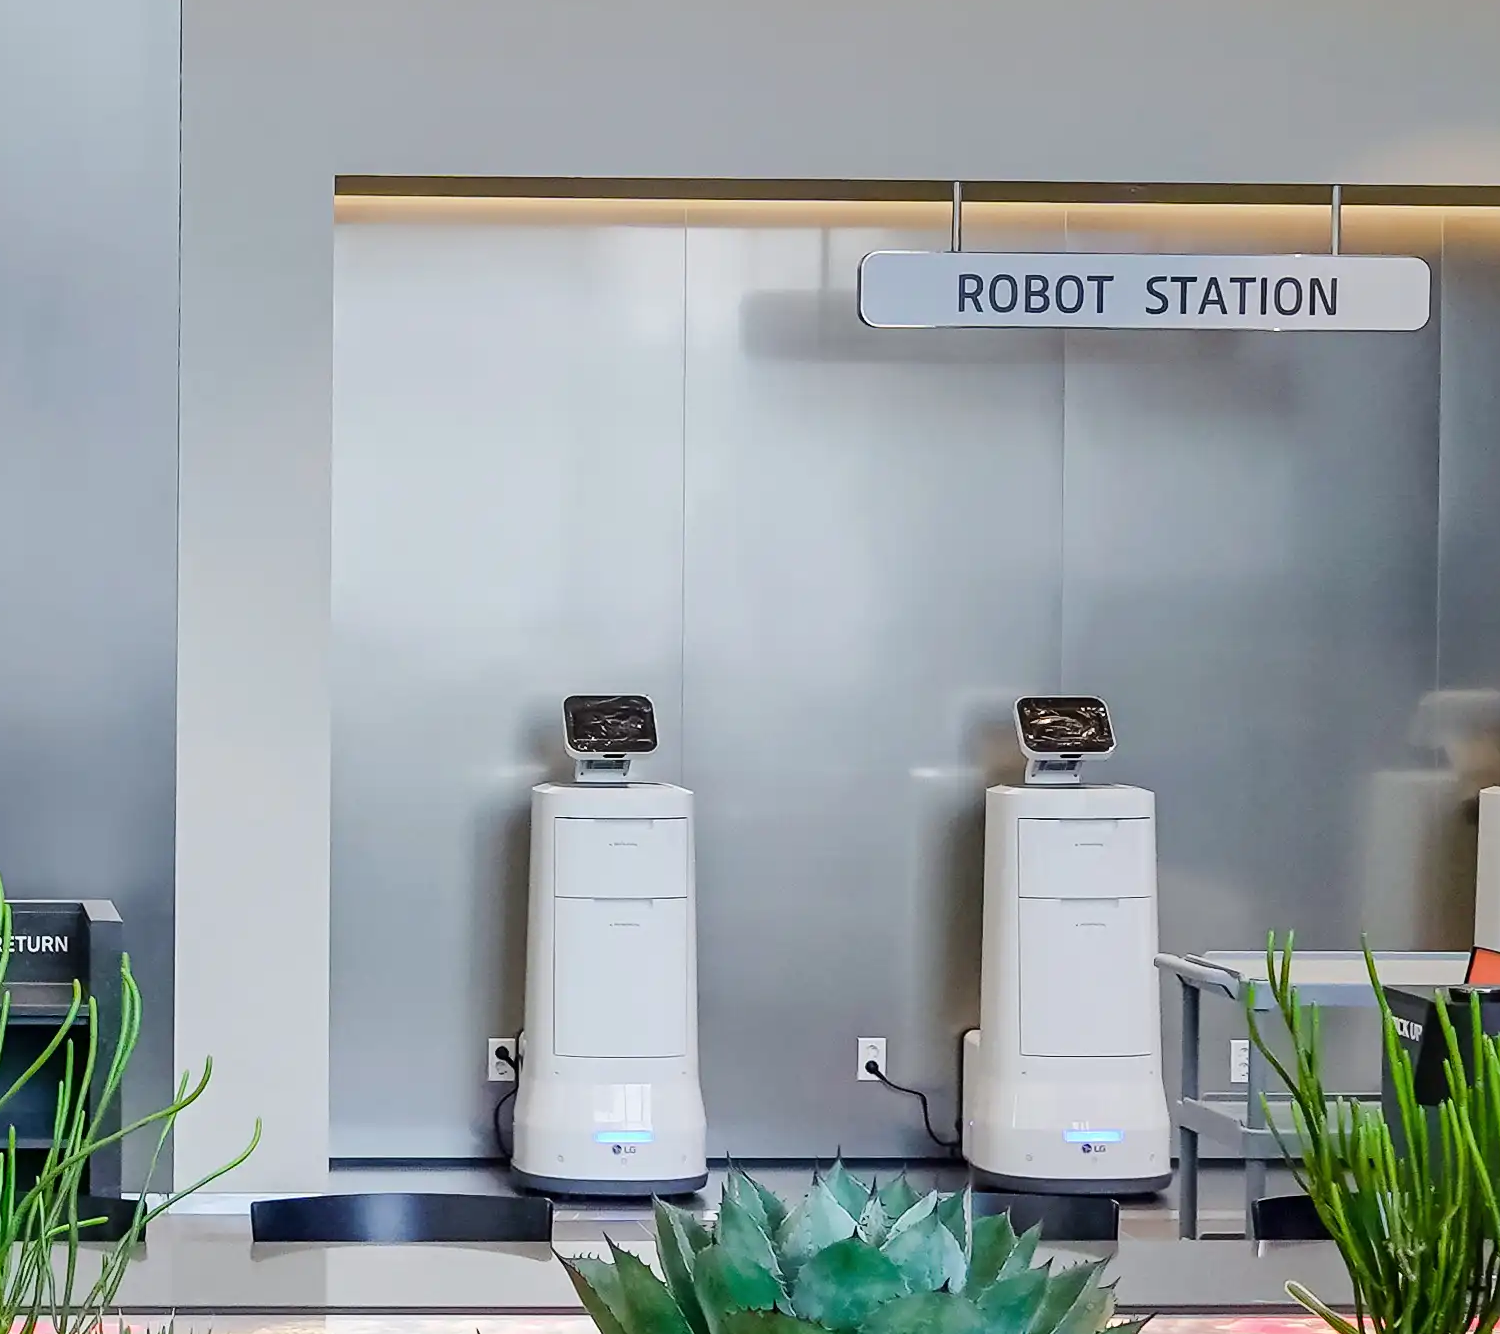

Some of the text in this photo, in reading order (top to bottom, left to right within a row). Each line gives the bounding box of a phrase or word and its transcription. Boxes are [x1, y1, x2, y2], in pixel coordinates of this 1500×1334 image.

[957, 273, 1340, 317] ROBOT STATION
[1409, 1021, 1423, 1042] UP
